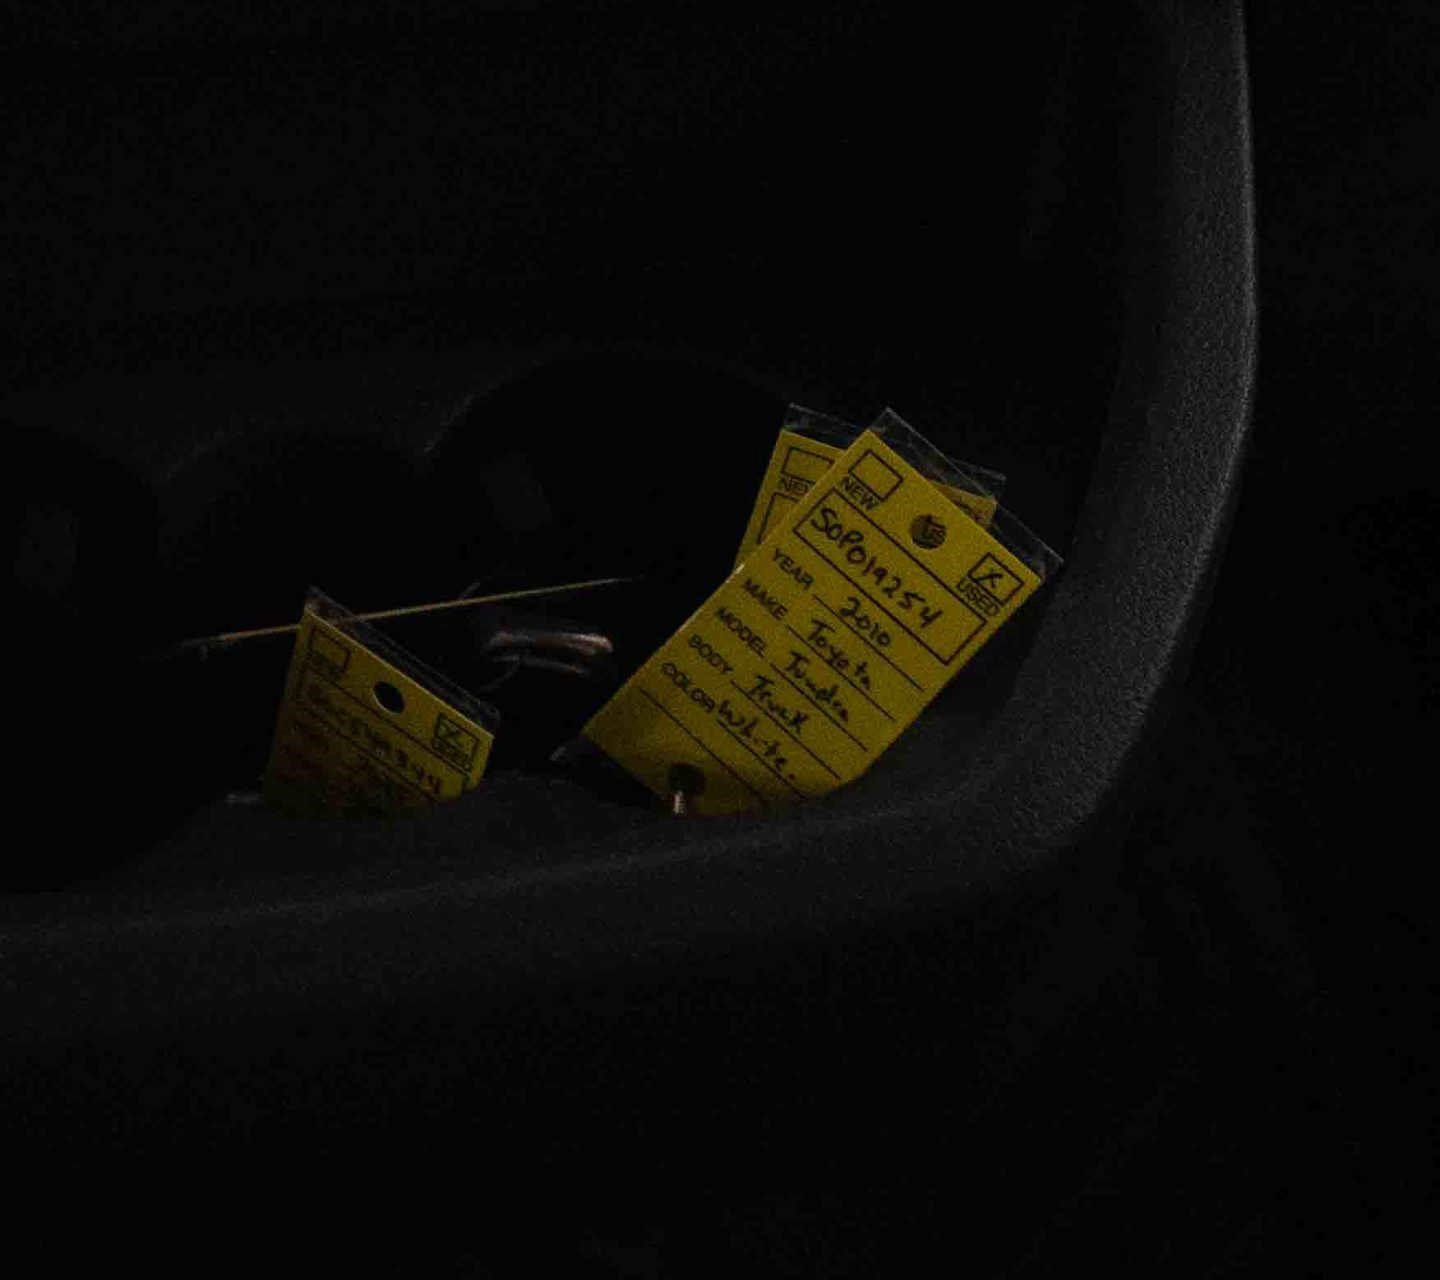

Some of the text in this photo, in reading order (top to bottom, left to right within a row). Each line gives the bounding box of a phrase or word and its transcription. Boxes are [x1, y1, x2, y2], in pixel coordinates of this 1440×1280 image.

[840, 477, 878, 511] NEW
[772, 549, 815, 589] YEAR
[743, 578, 788, 620] MAKE
[958, 579, 1001, 618] USED
[688, 635, 734, 675] BODY
